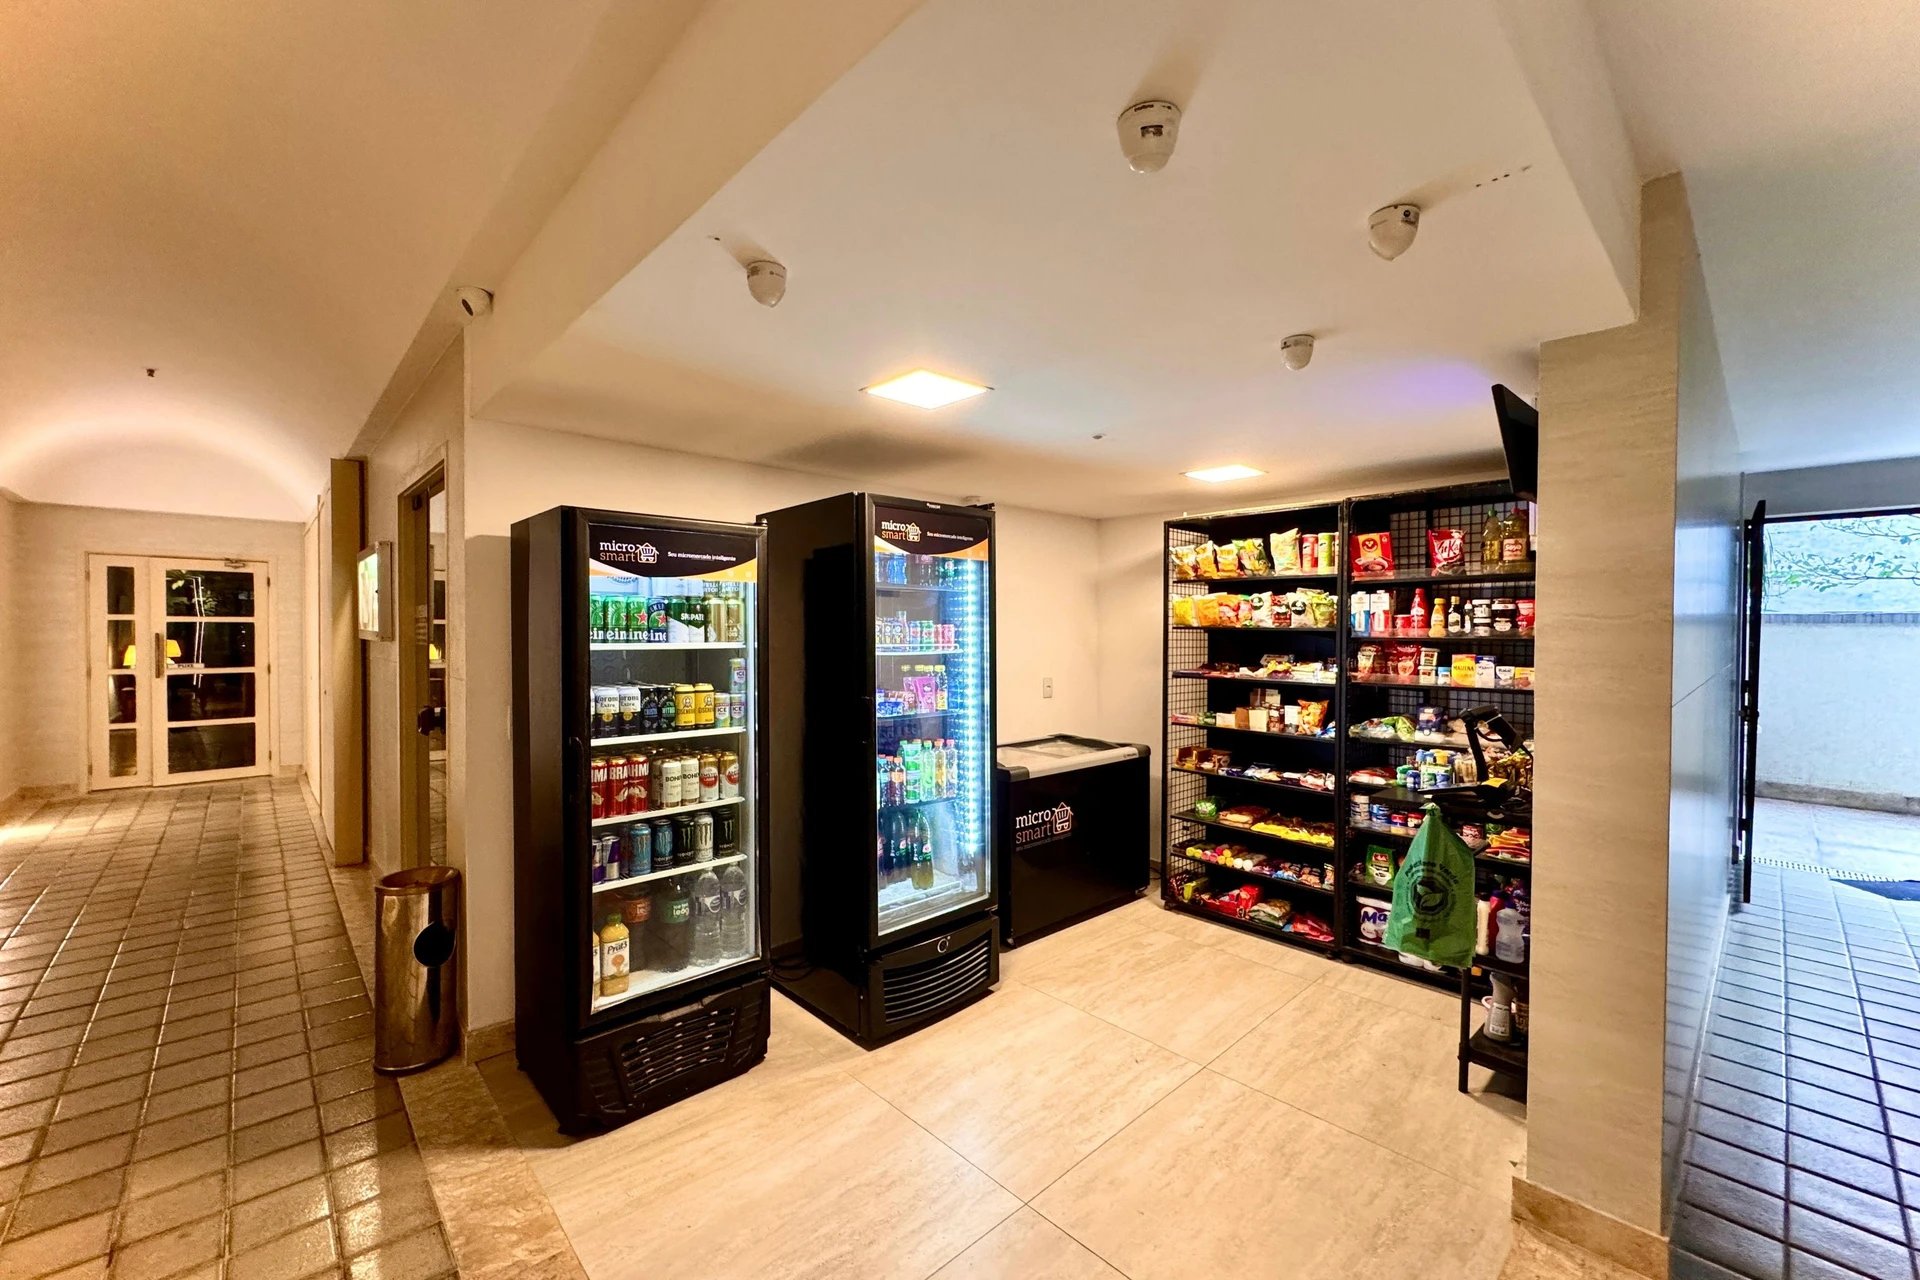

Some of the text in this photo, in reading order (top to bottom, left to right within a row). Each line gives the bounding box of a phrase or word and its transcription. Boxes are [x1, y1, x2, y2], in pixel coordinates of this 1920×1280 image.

[881, 520, 906, 531] micro
[881, 530, 906, 540] smart
[599, 540, 636, 552] micro
[600, 552, 636, 562] smart
[1015, 809, 1052, 828] micro
[1015, 821, 1052, 844] smart
